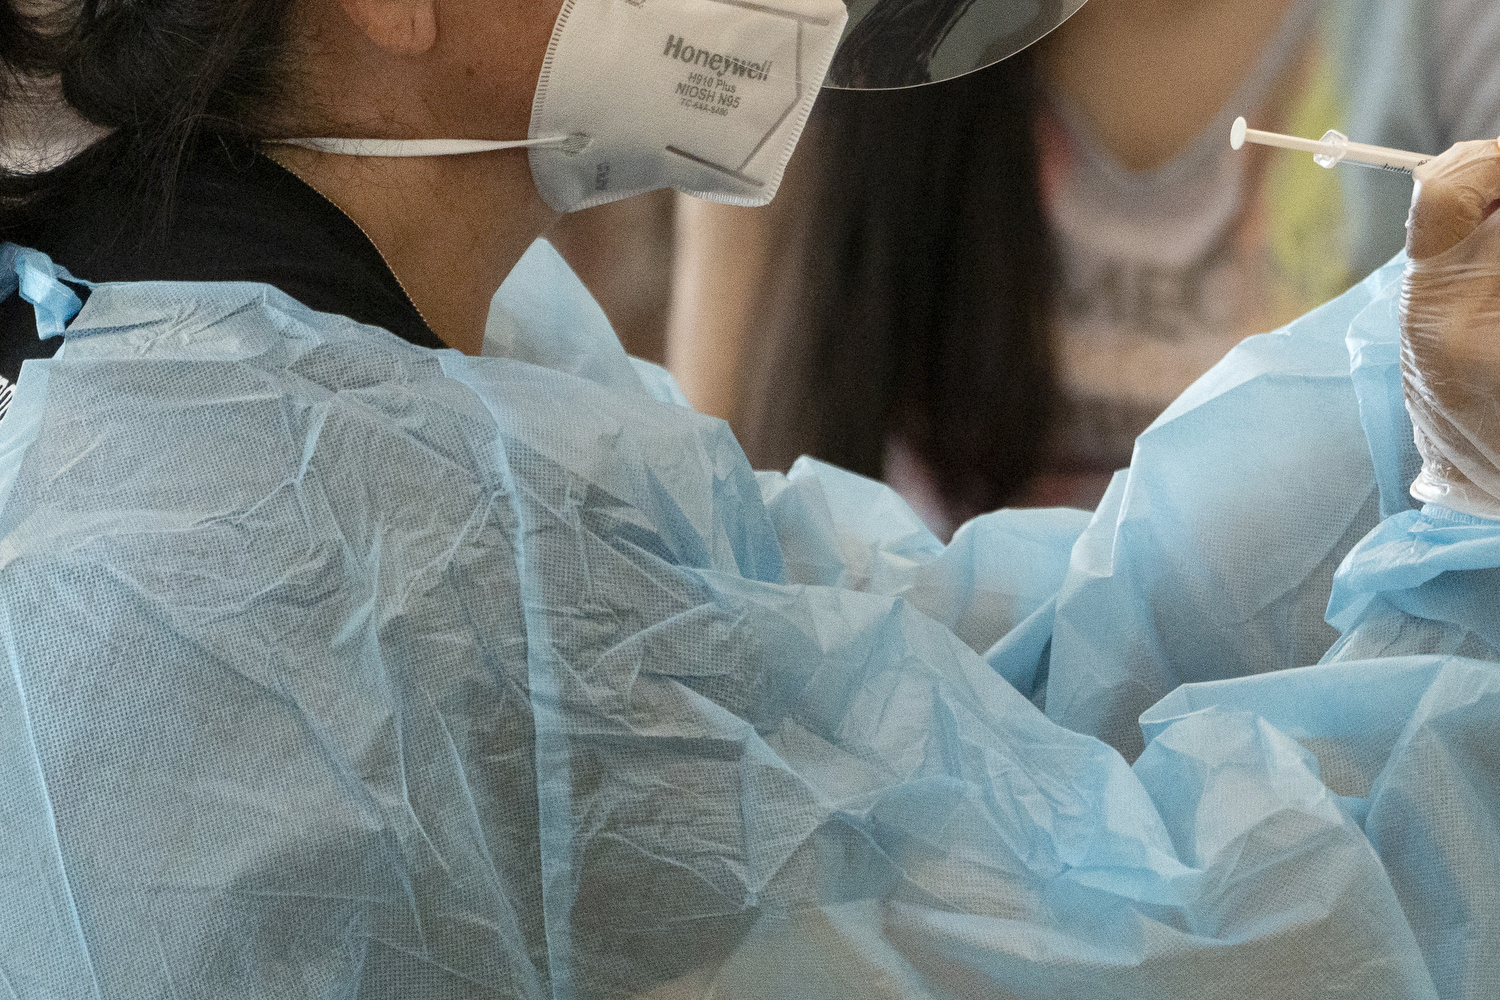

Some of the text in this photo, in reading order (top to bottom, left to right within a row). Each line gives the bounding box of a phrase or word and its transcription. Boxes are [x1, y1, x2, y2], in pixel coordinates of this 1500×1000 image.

[663, 34, 773, 81] Honeywell
[675, 83, 741, 109] NIOSH N95
[715, 79, 737, 94] Plus
